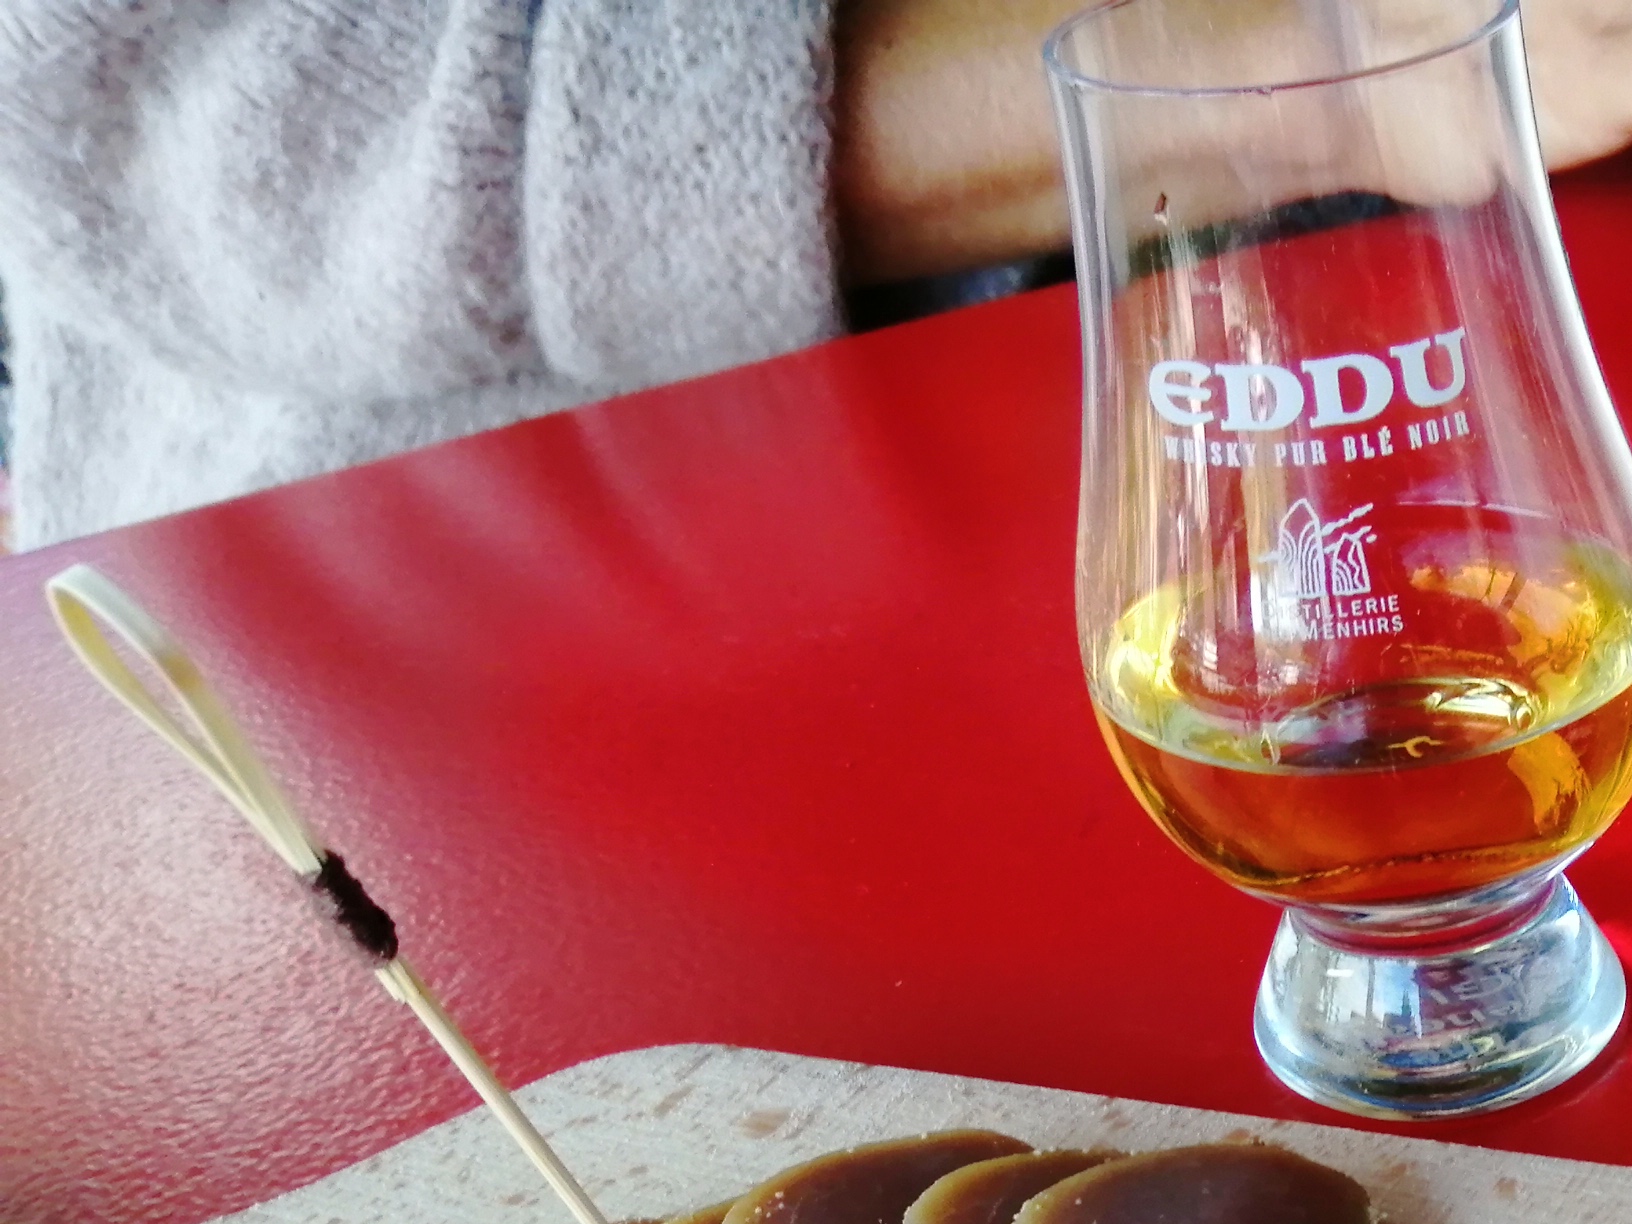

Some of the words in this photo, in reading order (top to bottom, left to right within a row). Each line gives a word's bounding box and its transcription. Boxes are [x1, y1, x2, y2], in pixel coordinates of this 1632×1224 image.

[1274, 439, 1328, 468] PUR
[1343, 426, 1394, 463] BLÉ
[1409, 410, 1471, 450] NOIR
